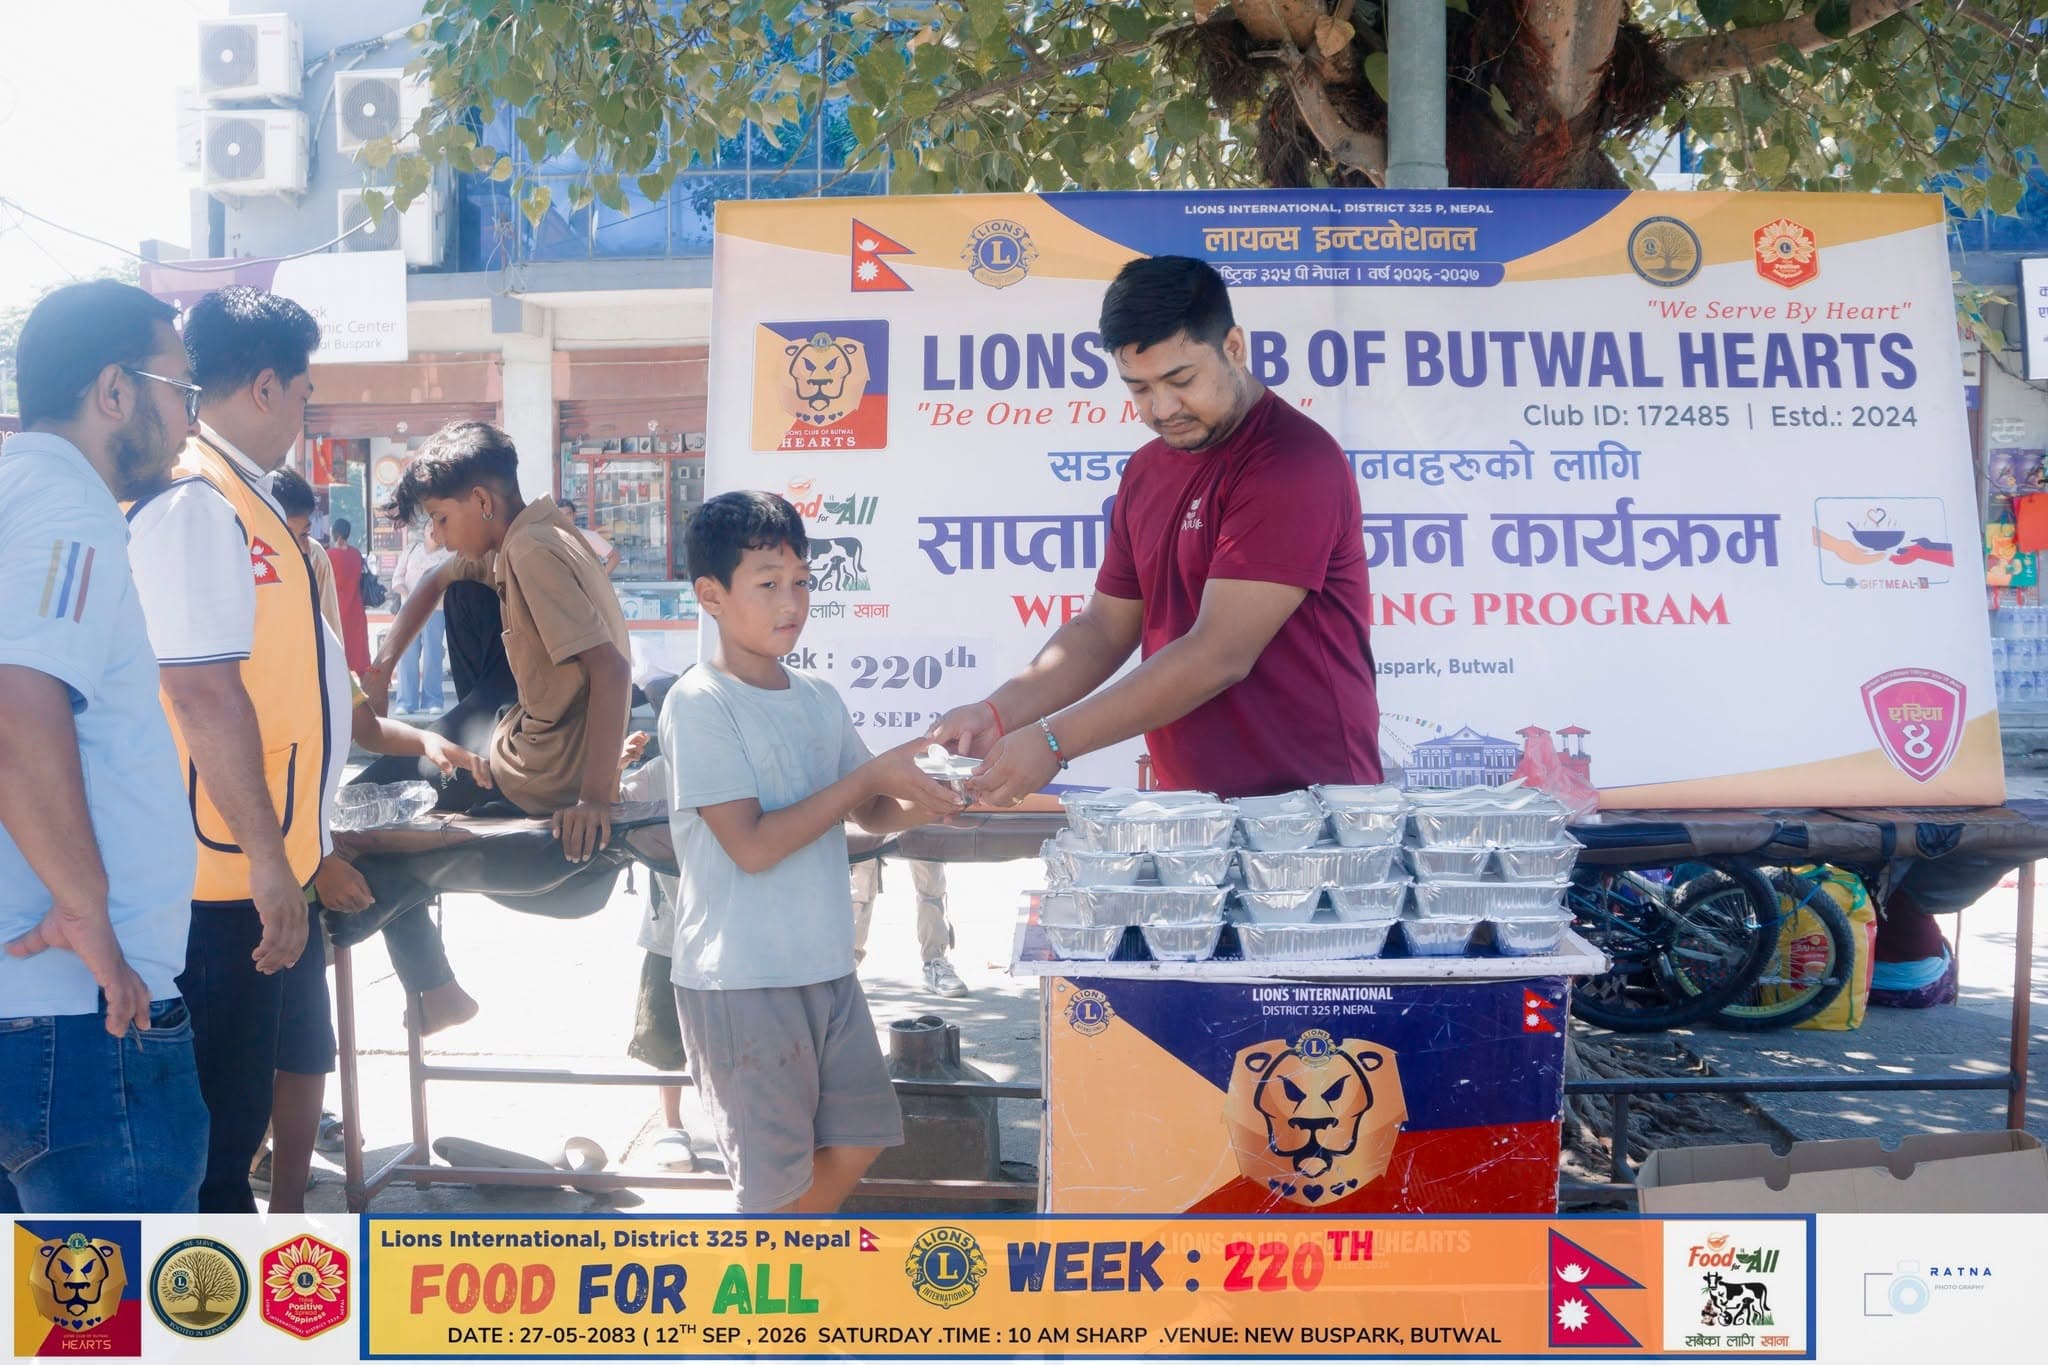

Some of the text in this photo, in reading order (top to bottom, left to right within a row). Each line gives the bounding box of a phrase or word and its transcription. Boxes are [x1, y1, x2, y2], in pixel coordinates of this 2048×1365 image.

[1184, 203, 1494, 215] LIONS INTERNATIONAL, DISTRICT 325 P, NEPAL
[977, 222, 1022, 238] LIONS
[1202, 218, 1478, 253] लायन्स इन्टरनेशनल
[991, 240, 1011, 265] L
[1213, 264, 1257, 285] ष्ट्रिक
[1295, 264, 1309, 281] पी
[1312, 264, 1350, 281] नेपाल
[1368, 264, 1391, 281] वर्ष
[1648, 299, 1912, 324] "We Serve By Heart"
[922, 331, 1109, 391] LIONS
[1307, 329, 1386, 388] OF
[1404, 330, 1665, 389] BUTWAL
[1678, 331, 1918, 390] HEARTS
[917, 401, 975, 427] "Be
[986, 400, 1054, 426] One
[1068, 400, 1107, 425] To
[1523, 403, 1585, 427] Club
[1594, 404, 1629, 426] ID:
[1636, 404, 1730, 427] 172485
[1771, 404, 1843, 427] Estd.:
[1851, 405, 1919, 428] 2024
[781, 436, 857, 448] HEARTS
[1345, 440, 1535, 486] ानवहरूको
[1550, 439, 1642, 482] लागि
[816, 514, 829, 524] for
[835, 495, 880, 525] All
[918, 494, 1117, 576] साप्ता
[1362, 512, 1469, 568] जन
[1489, 496, 1782, 572] कार्यक्रम
[853, 603, 891, 619] खाना
[1470, 591, 1732, 627] PROGRAM
[849, 646, 977, 690] 220th
[1375, 657, 1515, 677] uspark, Butwal
[850, 711, 866, 727] 2
[873, 711, 922, 728] SEP
[1252, 986, 1394, 1002] LIONS INTERNATIONAL
[1262, 1004, 1377, 1017] DISTRICT 325 P, NEPAL
